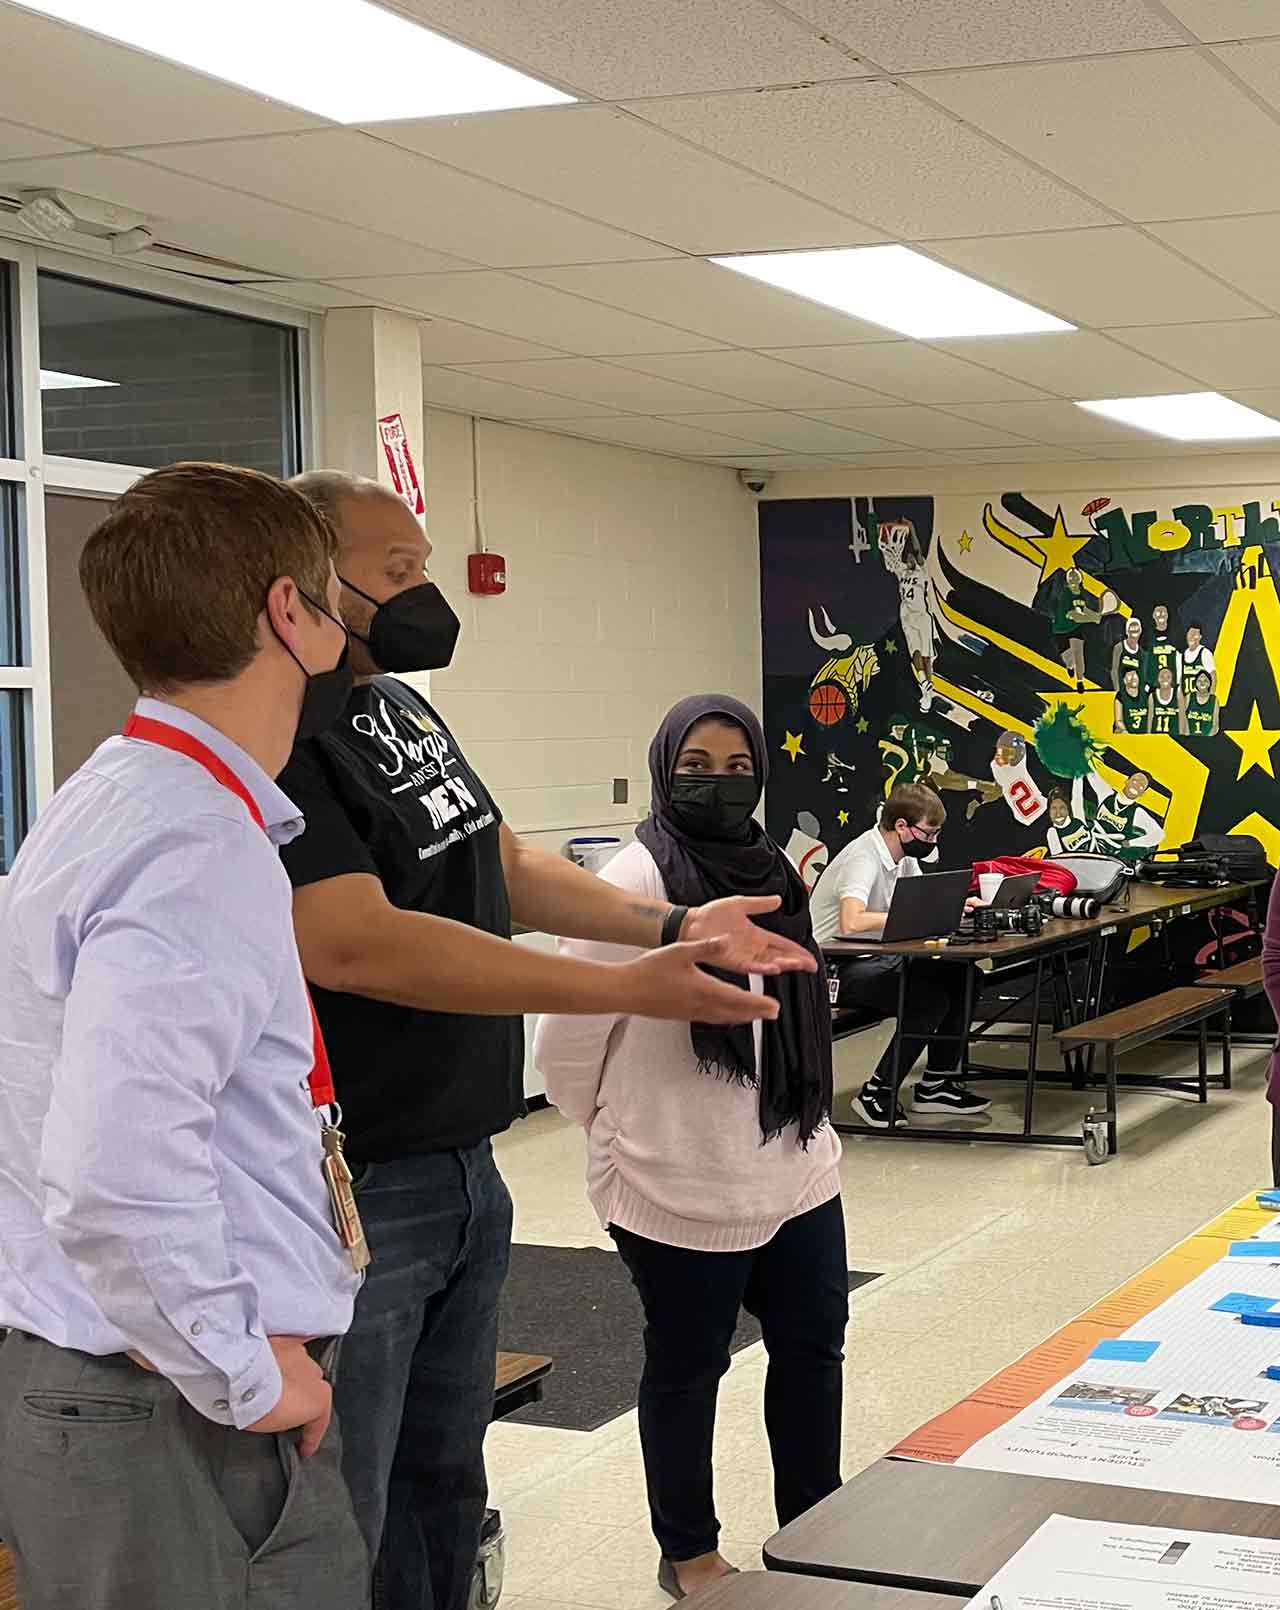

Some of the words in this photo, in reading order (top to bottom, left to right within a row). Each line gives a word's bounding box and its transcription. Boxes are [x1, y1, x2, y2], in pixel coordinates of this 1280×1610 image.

[1009, 779, 1040, 818] 2
[1006, 1446, 1087, 1460] OPPORTUNITY
[1090, 1456, 1145, 1467] STUDENT
